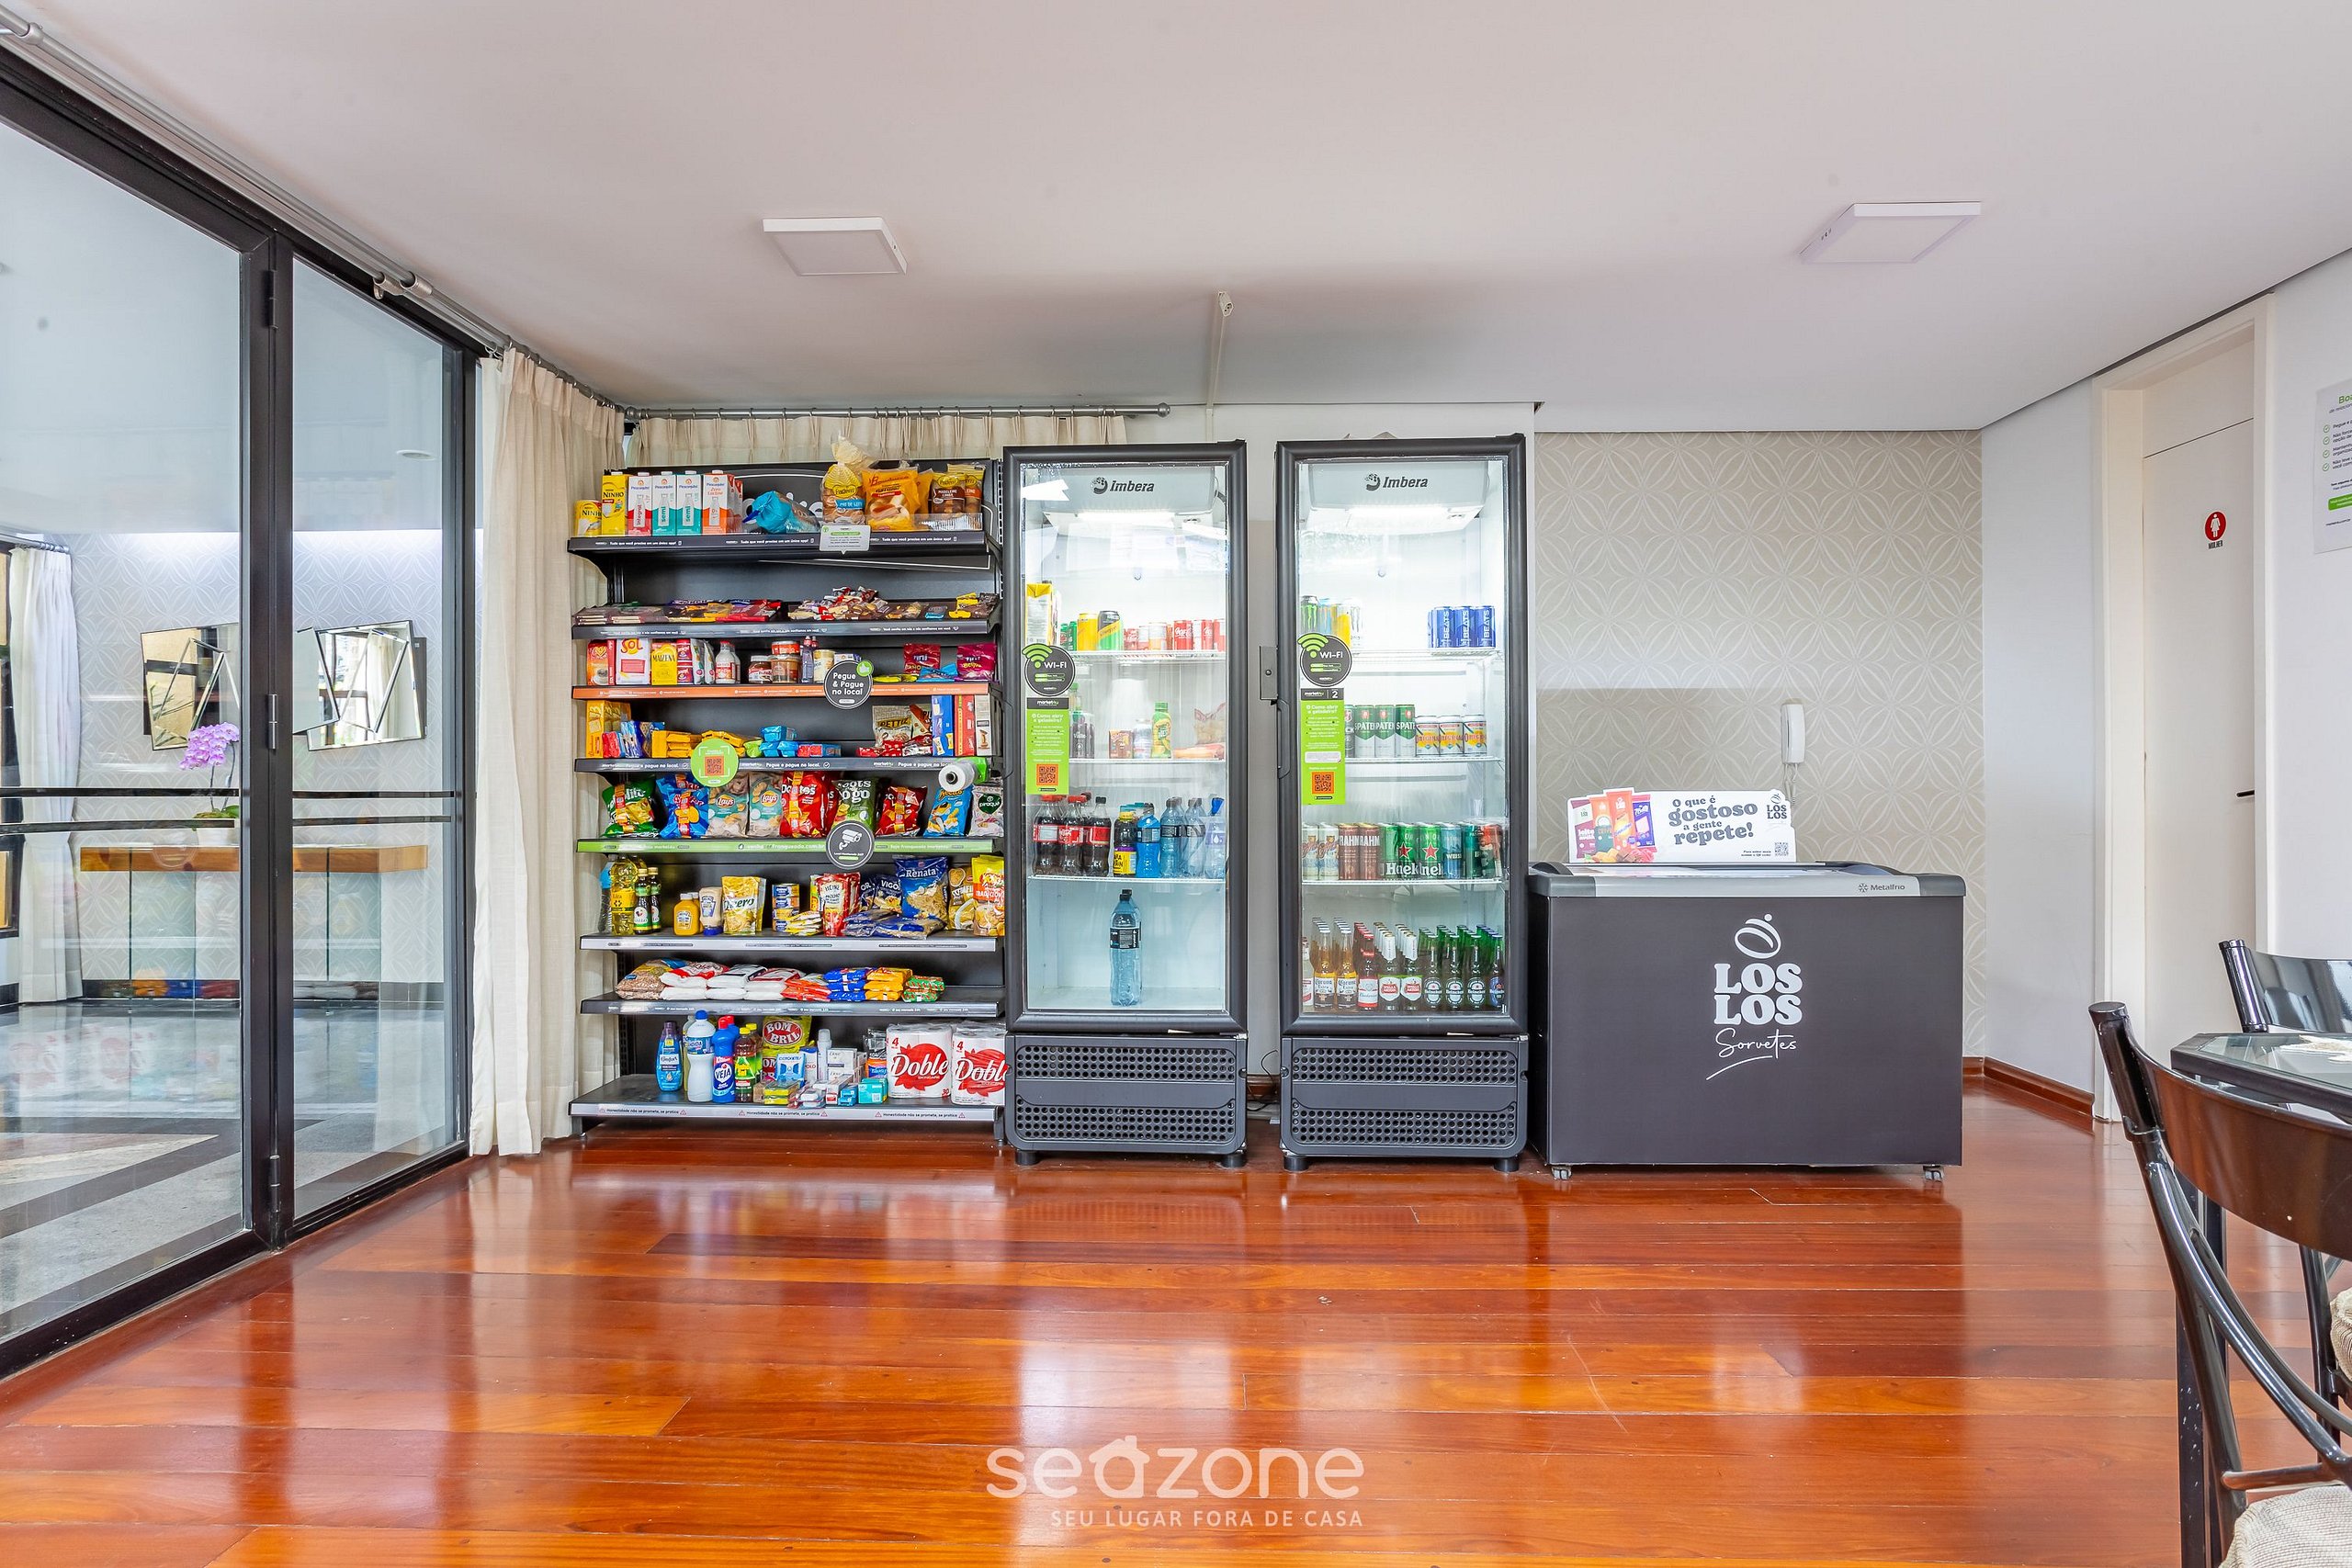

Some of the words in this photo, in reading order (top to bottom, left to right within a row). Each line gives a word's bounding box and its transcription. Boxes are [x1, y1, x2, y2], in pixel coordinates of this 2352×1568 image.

[1109, 480, 1155, 492] Imbera
[1383, 476, 1429, 488] Imbera
[2208, 540, 2223, 549] MULHER
[620, 638, 644, 653] SOL
[832, 671, 856, 680] Pegue
[841, 681, 865, 690] Pague
[781, 784, 816, 795] Dotos
[1671, 798, 1682, 808] O
[1684, 797, 1707, 808] que
[1709, 795, 1716, 804] é
[1766, 804, 1788, 812] LOS
[1668, 802, 1758, 827] gostoso
[1767, 811, 1788, 819] LOS
[1692, 820, 1723, 831] gente
[1674, 822, 1754, 846] repete!
[905, 867, 937, 877] Renata
[724, 897, 754, 910] Quero
[1713, 962, 1803, 994] LOS
[1713, 994, 1803, 1025] LOS
[766, 1021, 793, 1032] BOM
[771, 1032, 800, 1044] BRIL
[891, 1037, 899, 1046] 4
[1714, 1027, 1797, 1059] Sorvetes
[956, 1041, 964, 1051] 4
[890, 1053, 949, 1077] Doble
[715, 1068, 731, 1079] VEJA
